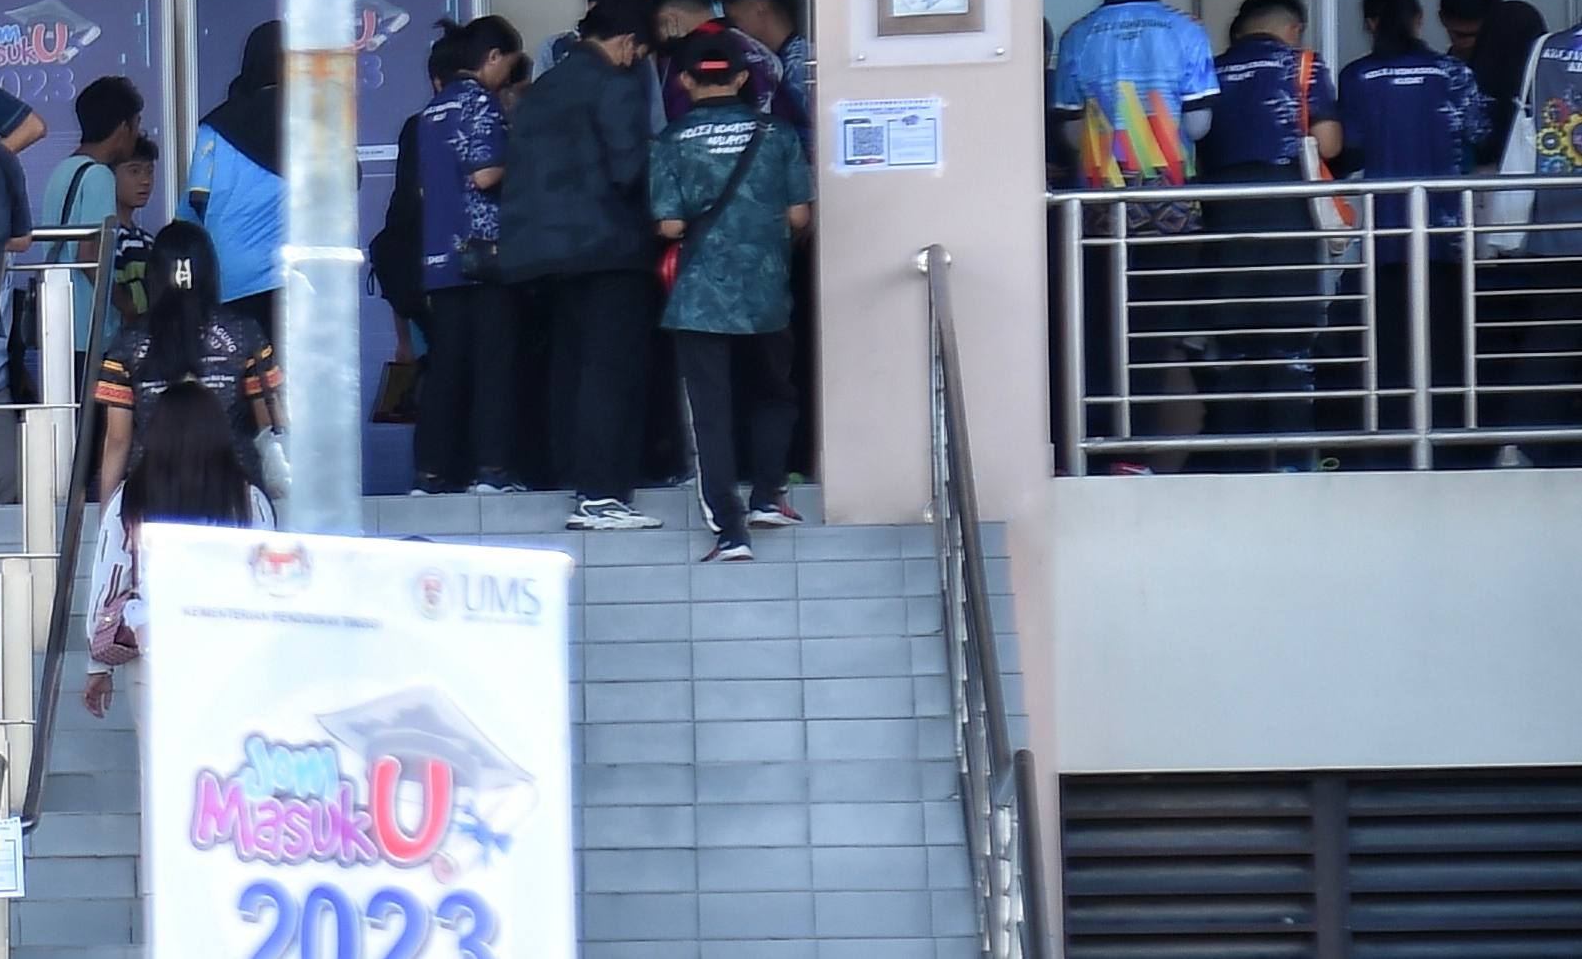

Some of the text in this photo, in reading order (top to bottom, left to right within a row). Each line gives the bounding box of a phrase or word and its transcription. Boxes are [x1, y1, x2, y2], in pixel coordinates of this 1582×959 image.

[460, 572, 542, 616] UMS
[239, 734, 340, 800] Jom
[236, 879, 501, 959] 2023
